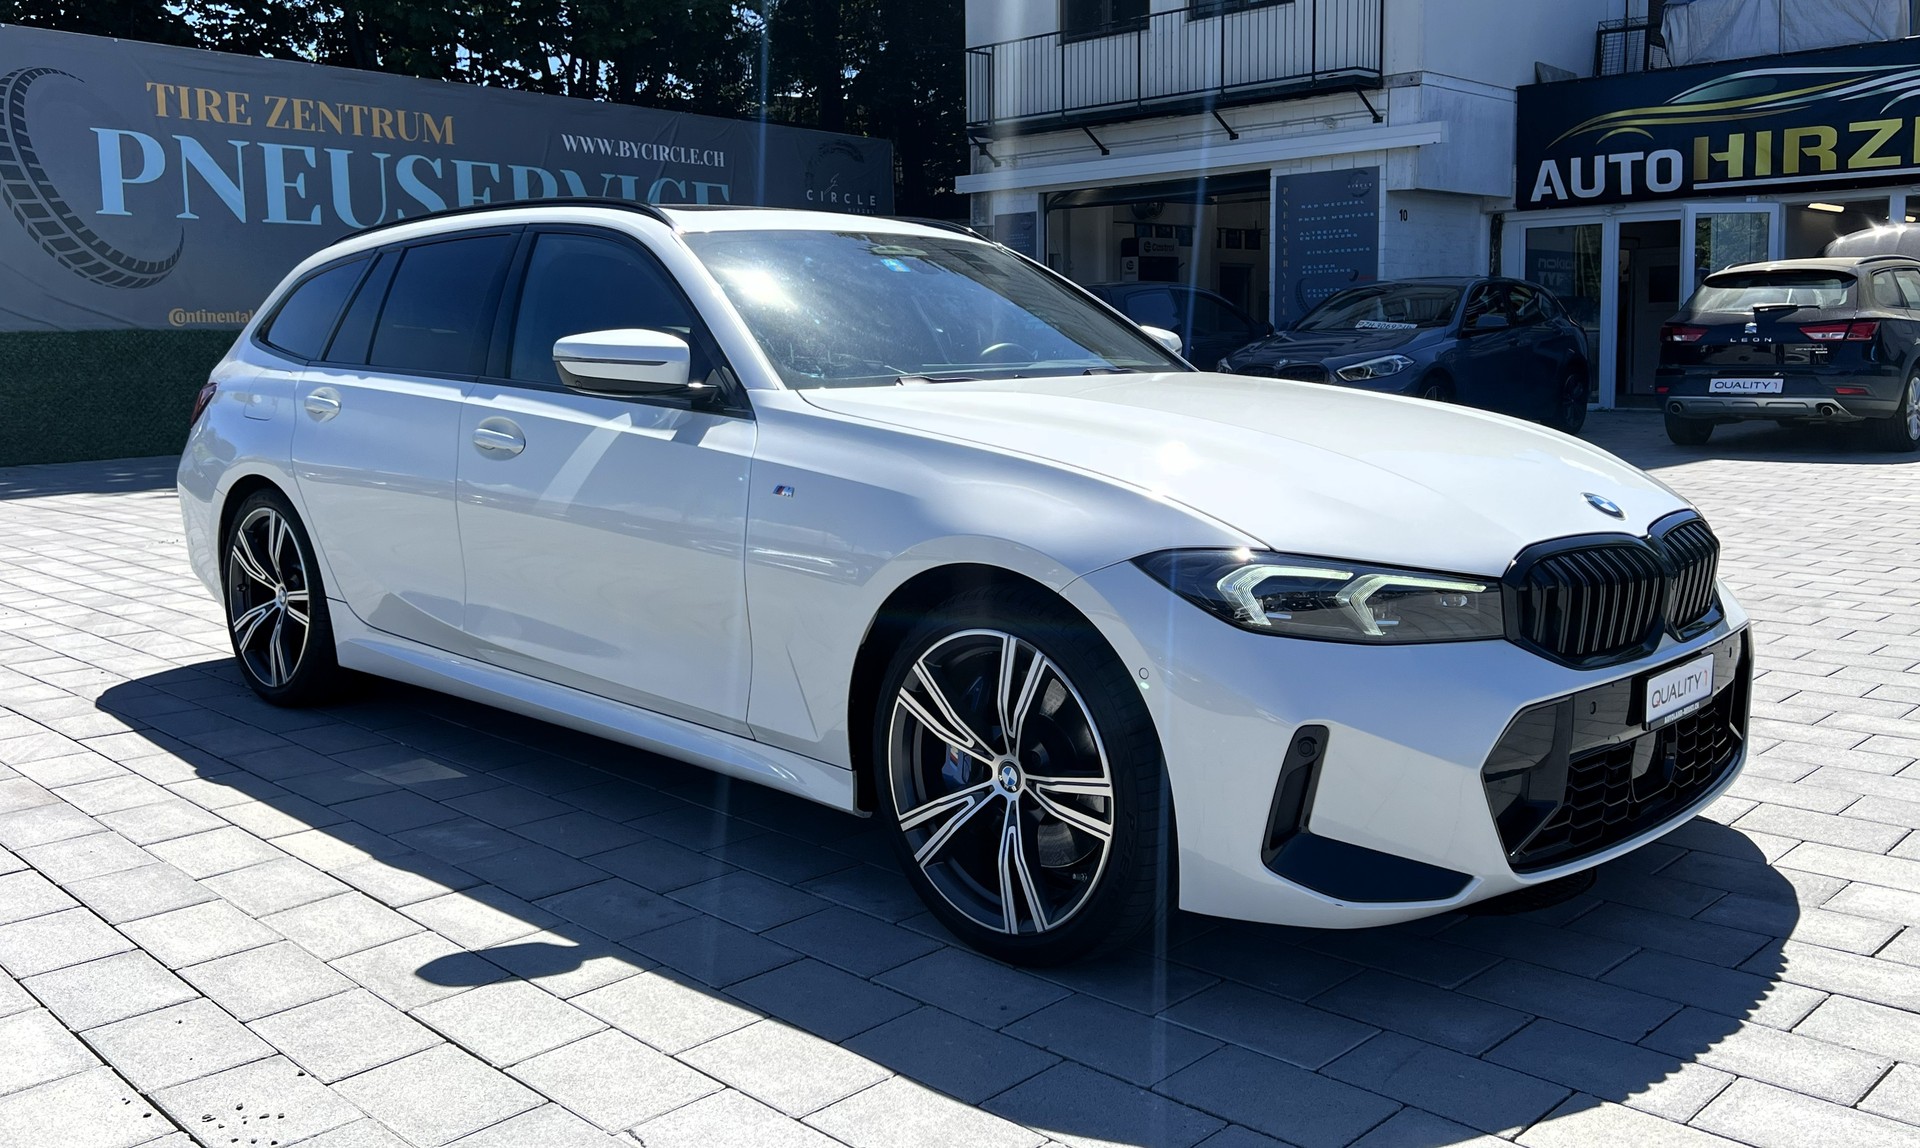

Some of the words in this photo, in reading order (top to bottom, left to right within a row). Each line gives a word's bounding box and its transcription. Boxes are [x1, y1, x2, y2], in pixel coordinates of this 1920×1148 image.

[146, 82, 251, 126] TIRE
[264, 95, 455, 146] ZENTRUM
[561, 133, 725, 167] WWW.BYCIRCLE.CH
[1530, 148, 1683, 203] AUTO
[1693, 116, 1920, 181] HIRZ
[806, 190, 876, 206] CIRCLE
[1399, 209, 1408, 221] 10
[168, 307, 254, 327] Continental
[1714, 381, 1771, 390] QUALITY
[1651, 671, 1702, 708] QUALITY
